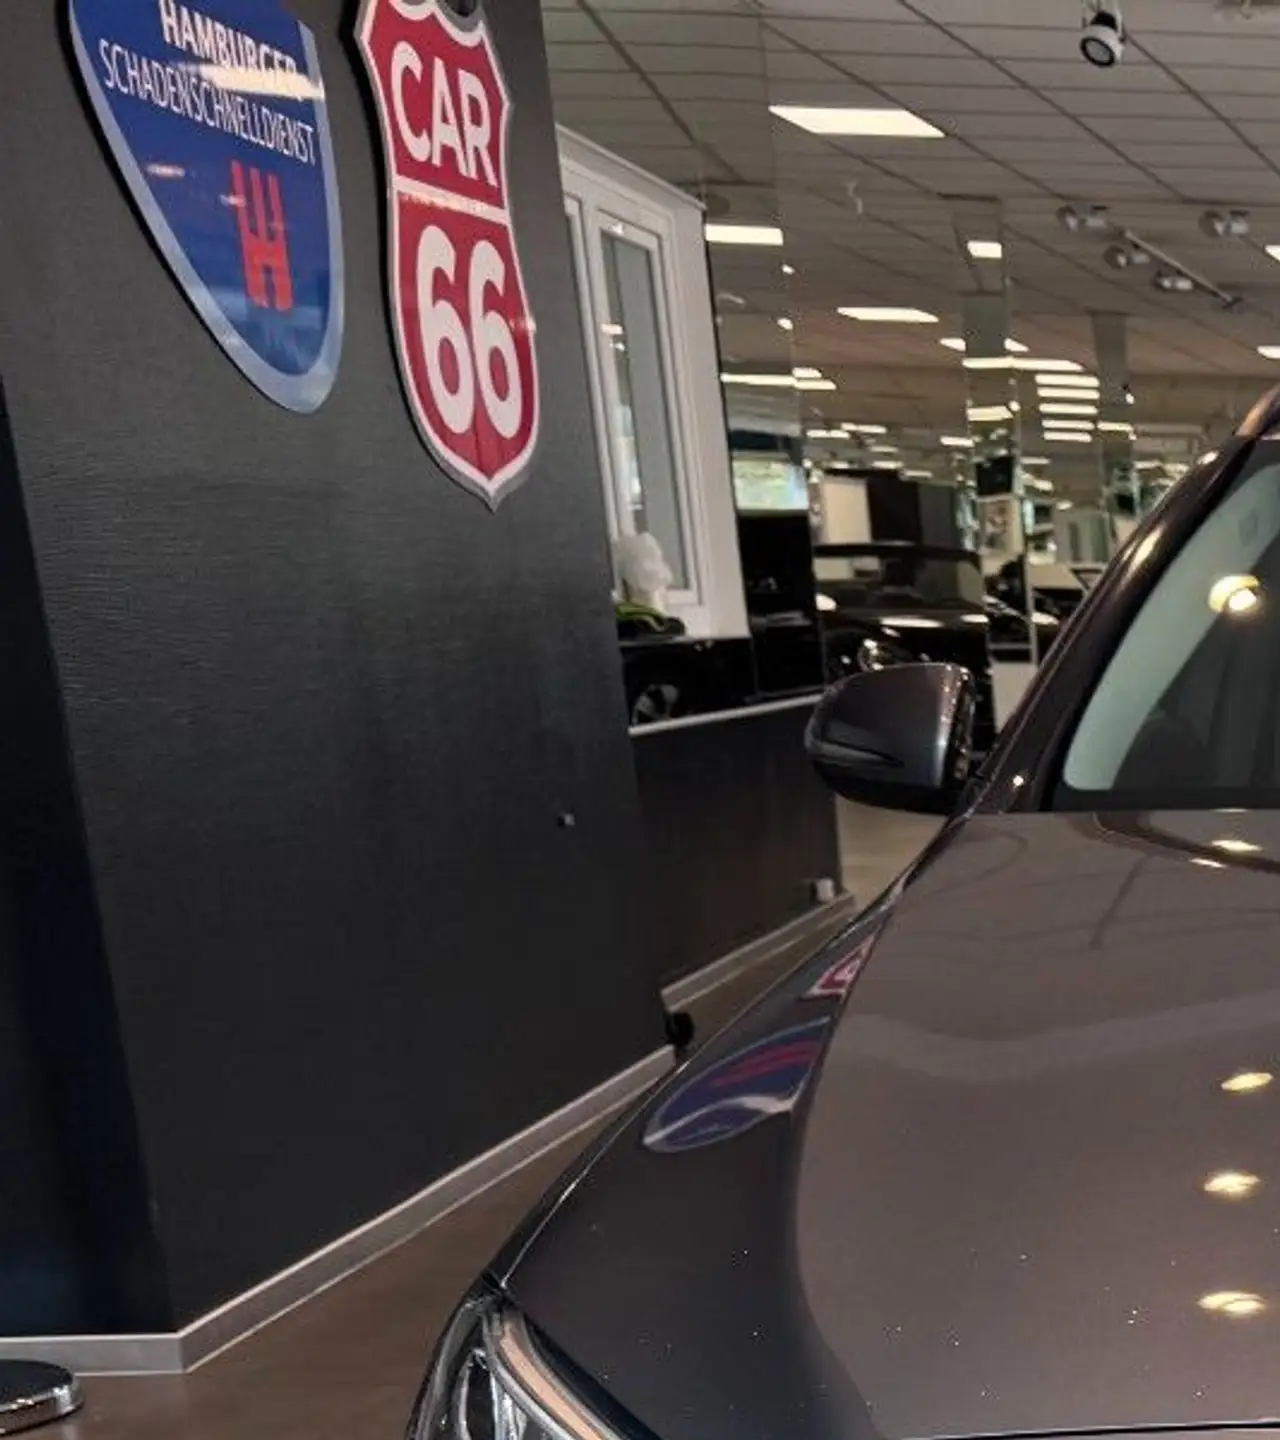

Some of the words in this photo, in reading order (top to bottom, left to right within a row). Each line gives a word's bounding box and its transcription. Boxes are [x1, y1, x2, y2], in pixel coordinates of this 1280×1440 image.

[100, 38, 316, 167] SCHADENSCHNELLDIENST
[391, 40, 498, 188] CAR
[416, 224, 521, 440] 66
